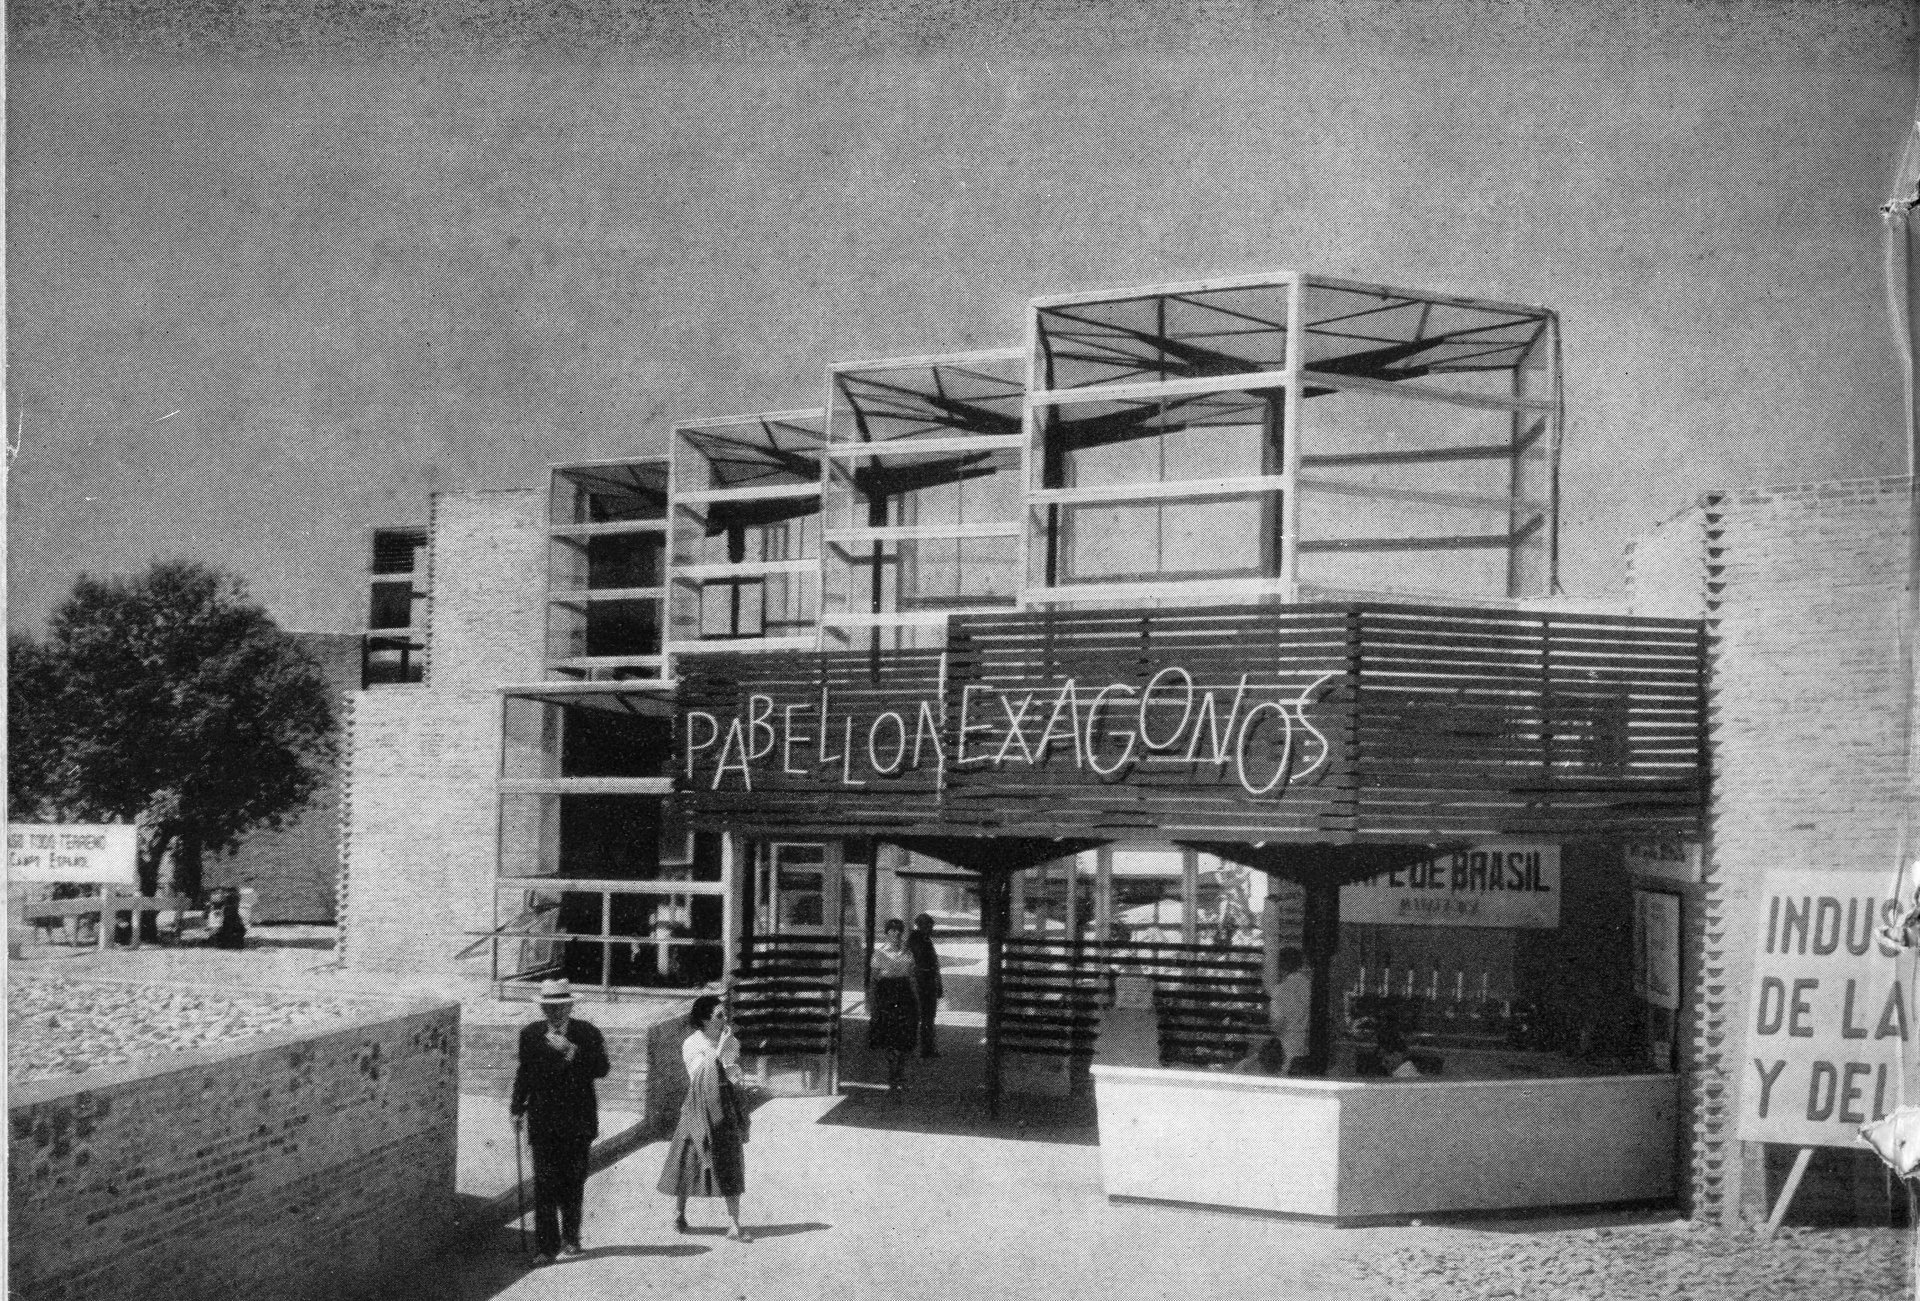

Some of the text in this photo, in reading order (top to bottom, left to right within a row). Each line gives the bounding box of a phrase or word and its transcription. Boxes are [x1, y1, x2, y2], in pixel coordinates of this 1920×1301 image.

[685, 667, 1335, 794] PABELLON EXAGONOS
[1452, 852, 1551, 892] BRASIL
[1756, 976, 1908, 1041] DE LA
[1754, 1058, 1888, 1123] Y DEL
